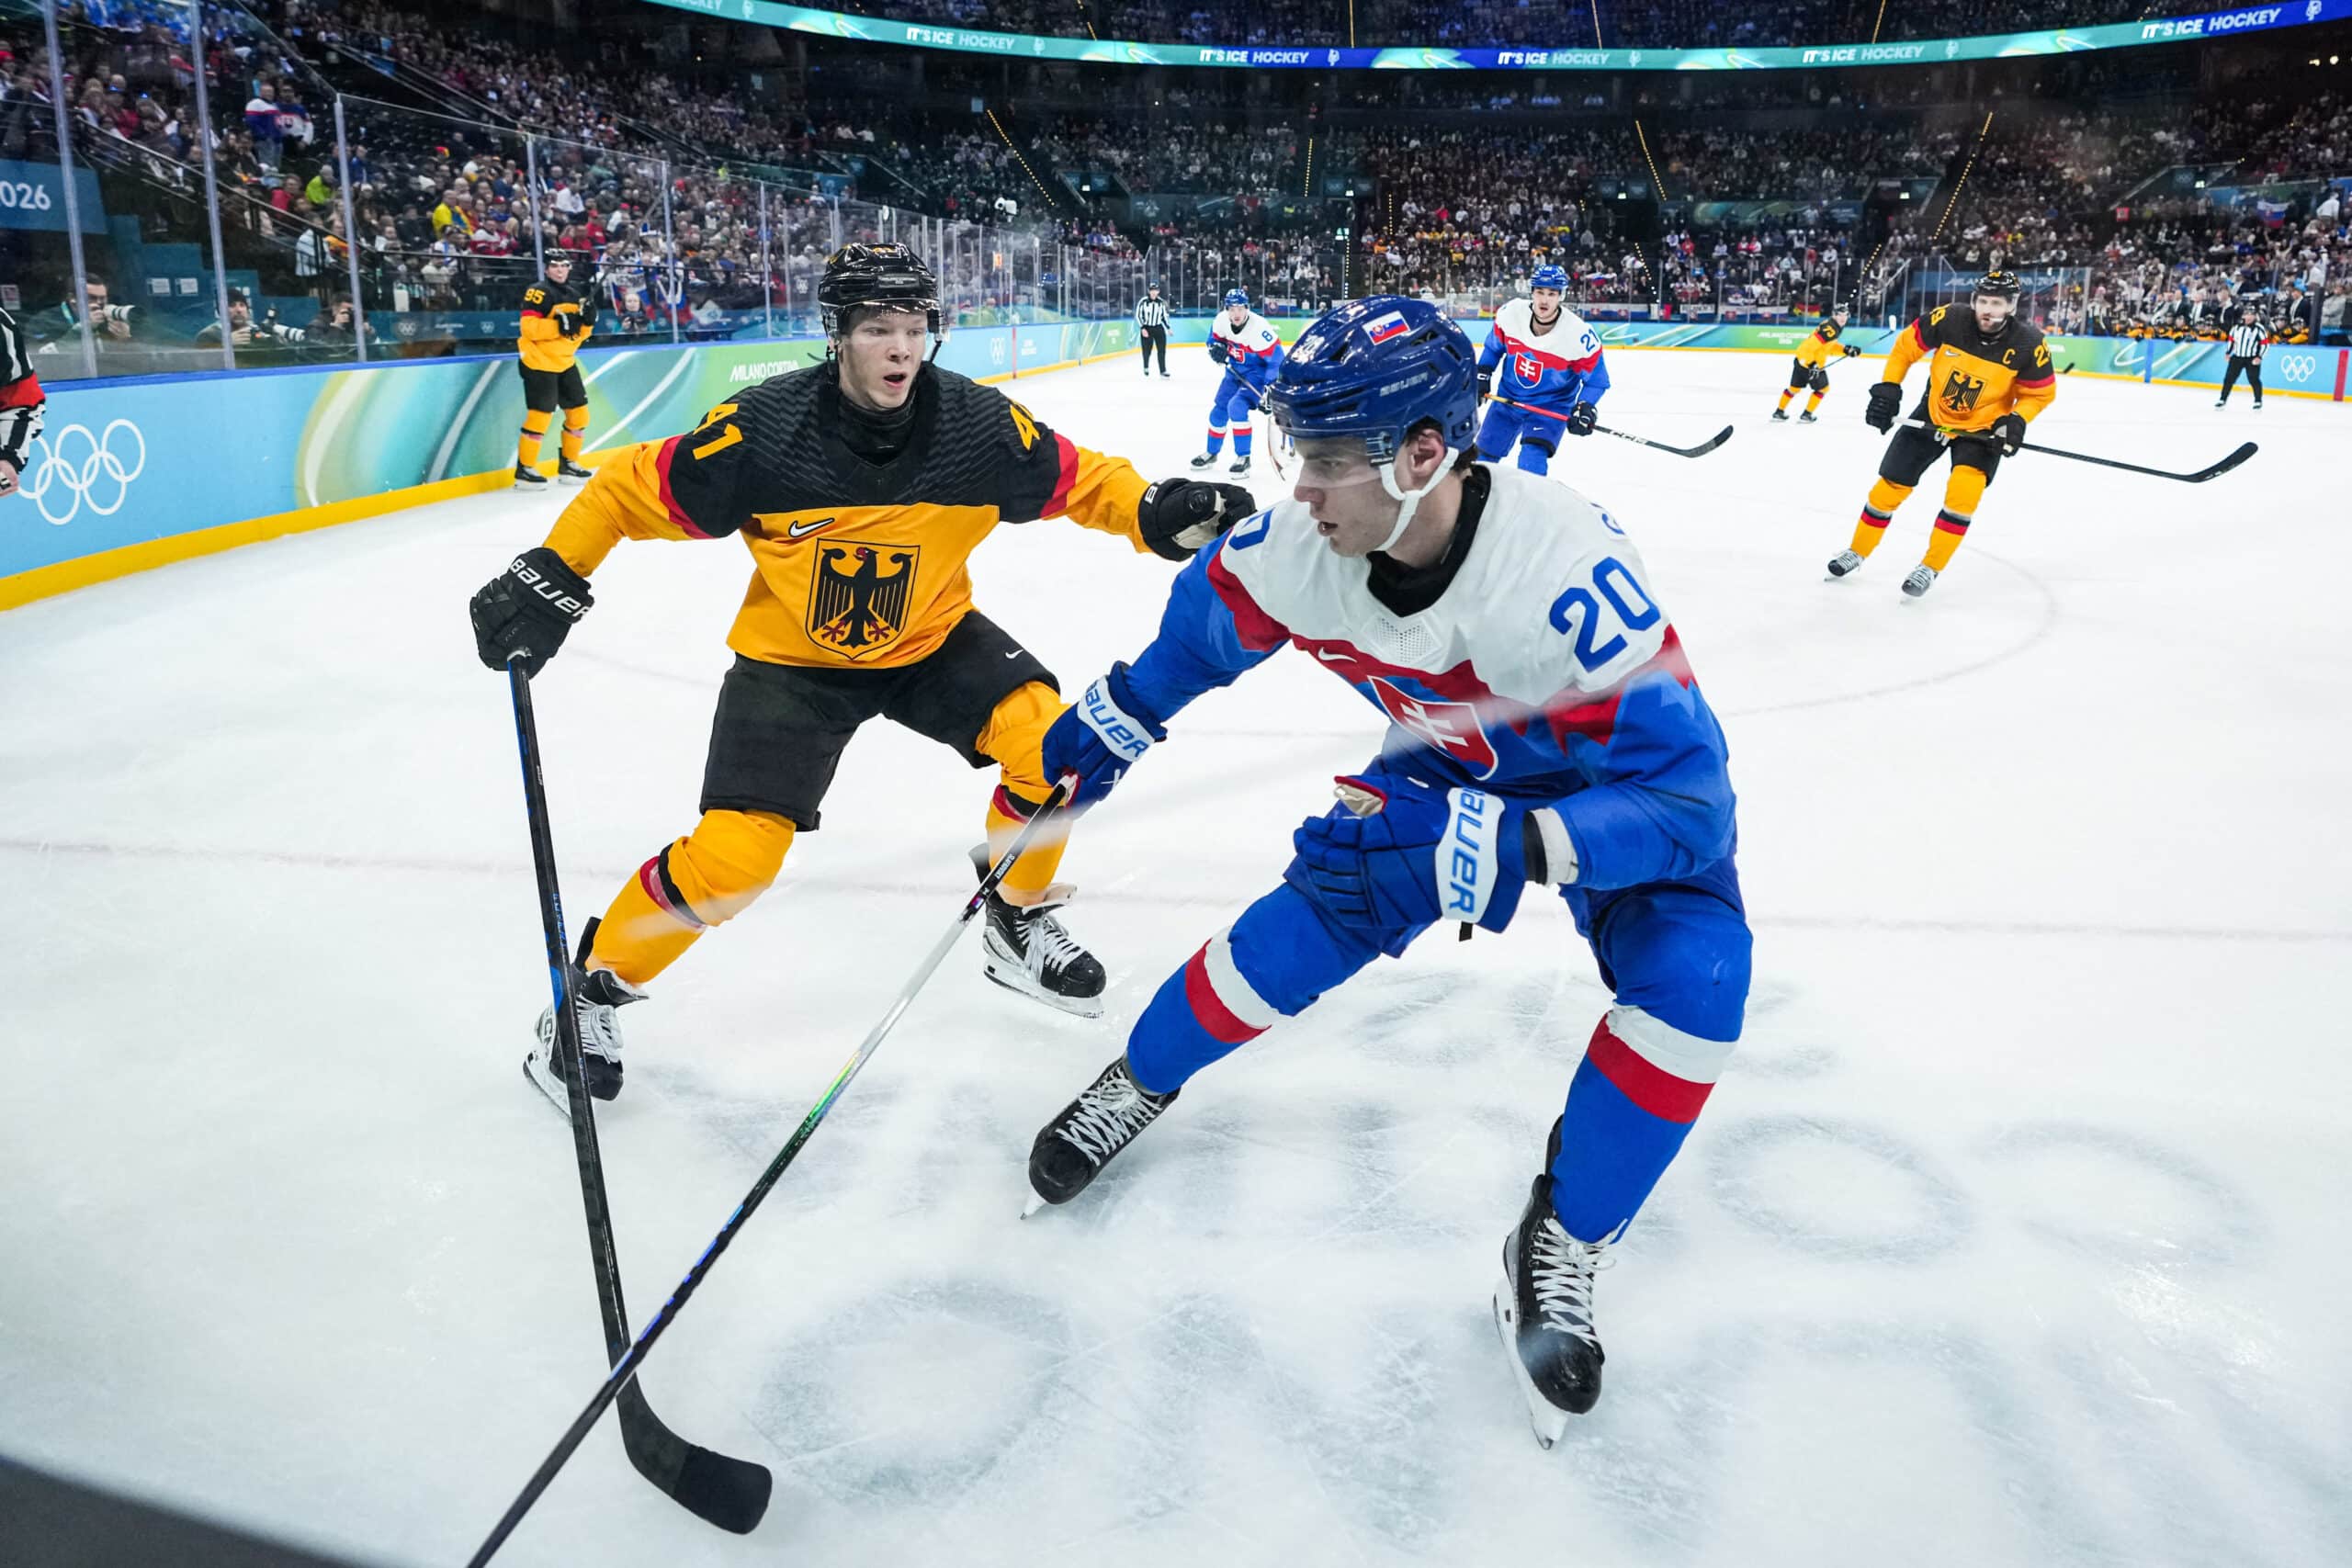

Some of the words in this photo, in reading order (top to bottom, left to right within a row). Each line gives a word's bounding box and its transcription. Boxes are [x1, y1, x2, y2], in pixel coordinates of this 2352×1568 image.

[2142, 22, 2174, 39] IT'S
[2176, 18, 2204, 36] ICE
[2208, 8, 2281, 31] HOCKEY
[906, 27, 931, 42] IT'S
[933, 30, 955, 44] ICE
[958, 33, 1014, 50] HOCKEY
[1199, 50, 1225, 62] IT'S
[1226, 50, 1249, 62] ICE
[1252, 51, 1309, 63] HOCKEY
[1498, 51, 1524, 65] IT'S
[1525, 51, 1548, 64] ICE
[1552, 52, 1610, 65] HOCKEY
[1803, 50, 1830, 63] IT'S
[1832, 49, 1856, 61] ICE
[1860, 46, 1925, 61] HOCKEY
[1261, 330, 1273, 342] 8
[1580, 328, 1600, 352] 21
[2002, 348, 2016, 366] C
[729, 362, 766, 382] MILANO
[510, 558, 589, 617] BAUER
[1548, 556, 1661, 672] 20
[1085, 681, 1149, 758] AUER
[1449, 787, 1486, 914] AUER
